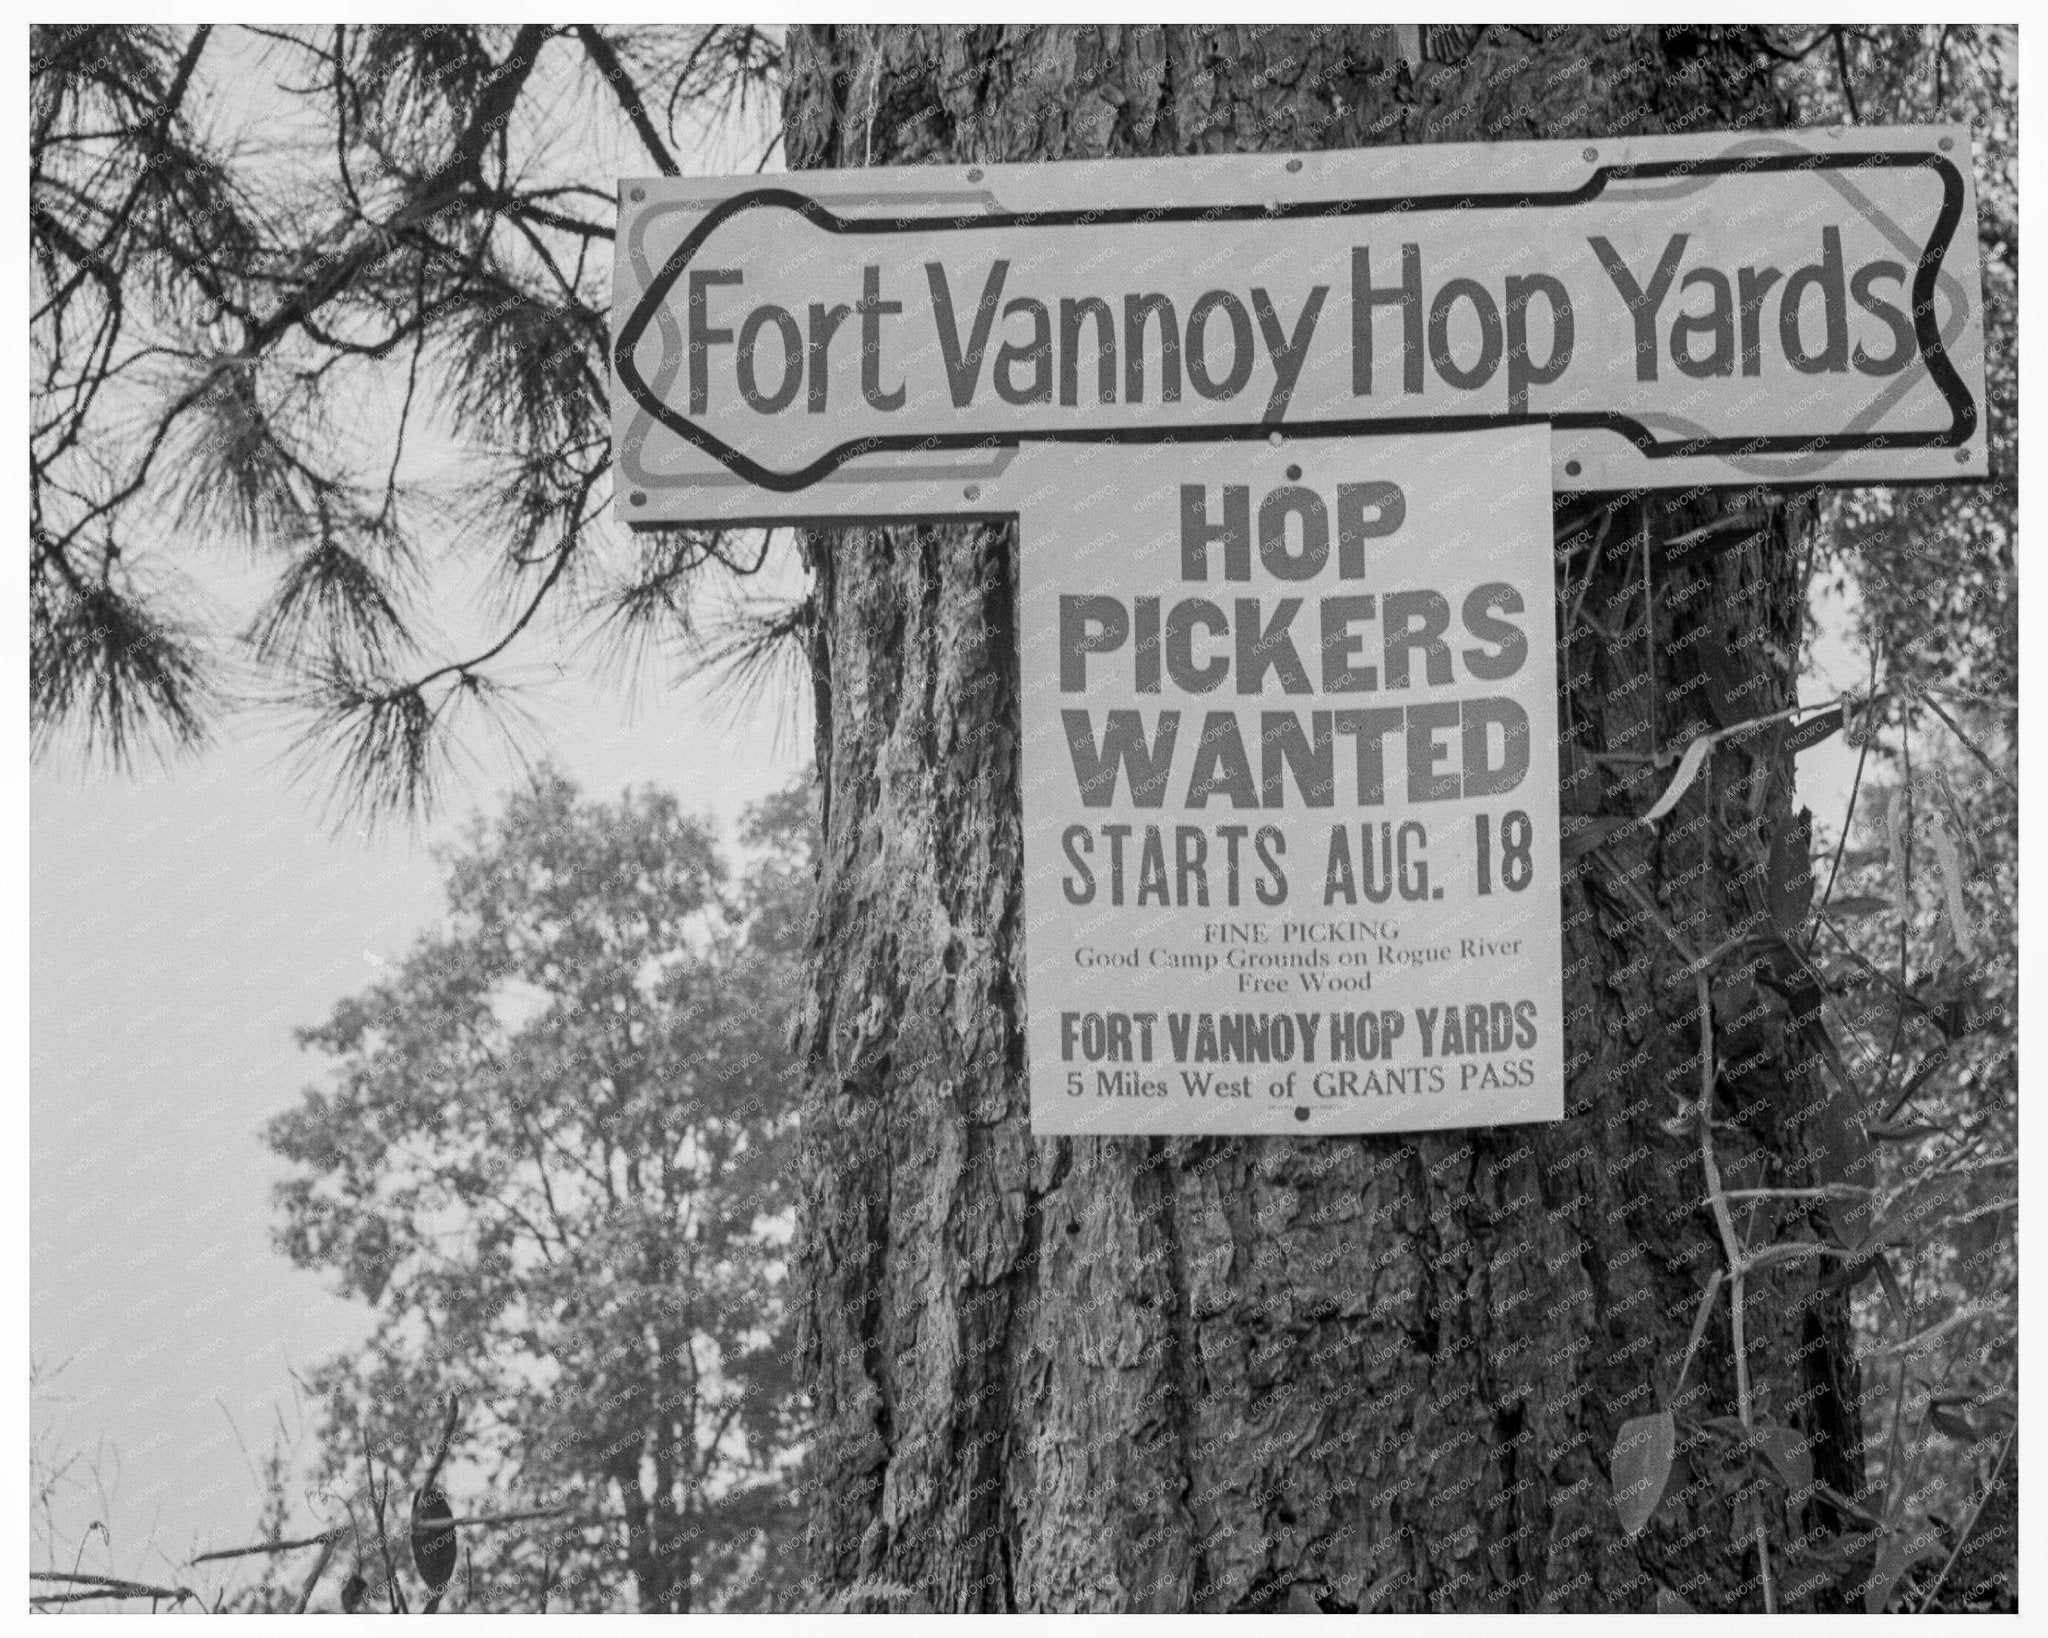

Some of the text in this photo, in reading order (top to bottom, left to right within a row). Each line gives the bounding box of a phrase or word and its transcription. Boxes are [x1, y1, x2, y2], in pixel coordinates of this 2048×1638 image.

[689, 225, 1917, 425] Fort Vannoy Hop Yards
[1180, 481, 1406, 582] HOP
[1059, 582, 1528, 695] PICKERS
[1060, 696, 1530, 809] WANTED
[1061, 810, 1534, 906] STARTS AUG. 18
[1074, 938, 1523, 972] Good Camp Grounds on Rogue River
[1204, 920, 1399, 944] FINE PICKING
[1237, 971, 1372, 993] Free Wood
[1061, 1000, 1538, 1063] FORT VANNOY HOP YARDS
[1066, 1059, 1536, 1099] 5 Miles West of GRANTS PASS
